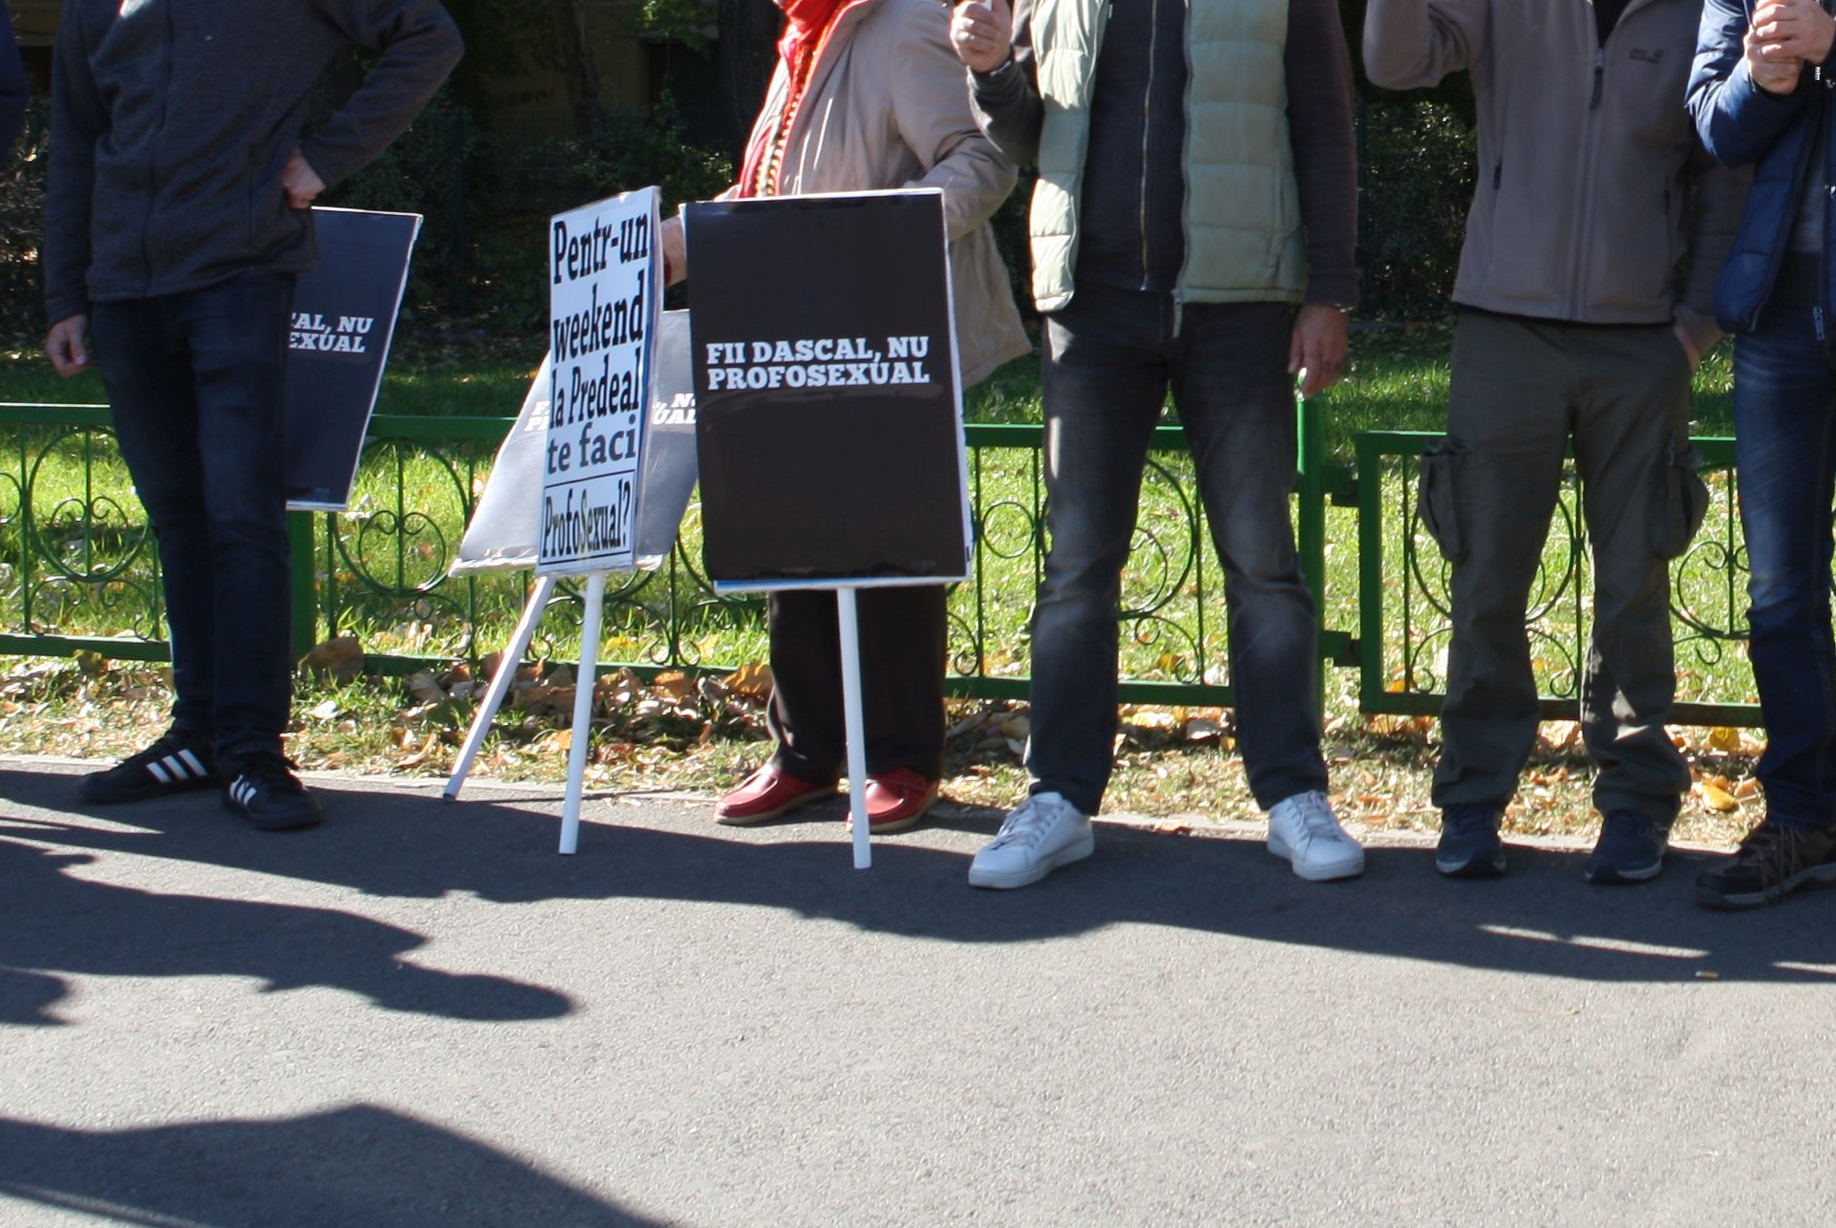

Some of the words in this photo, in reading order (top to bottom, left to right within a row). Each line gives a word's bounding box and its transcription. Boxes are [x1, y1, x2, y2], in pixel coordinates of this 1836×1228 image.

[553, 213, 648, 285] Pentr-un
[291, 312, 332, 334] AL,
[337, 316, 374, 334] NU
[553, 268, 645, 363] weekend
[706, 342, 745, 365] FII
[752, 338, 881, 363] DASCAL,
[887, 336, 929, 359] NU
[707, 361, 930, 391] PROFOSEXUAL
[550, 369, 564, 428] la
[567, 346, 639, 424] Predeal
[548, 439, 571, 474] te
[580, 414, 636, 467] faci
[542, 478, 631, 558] ProfoSexual?
